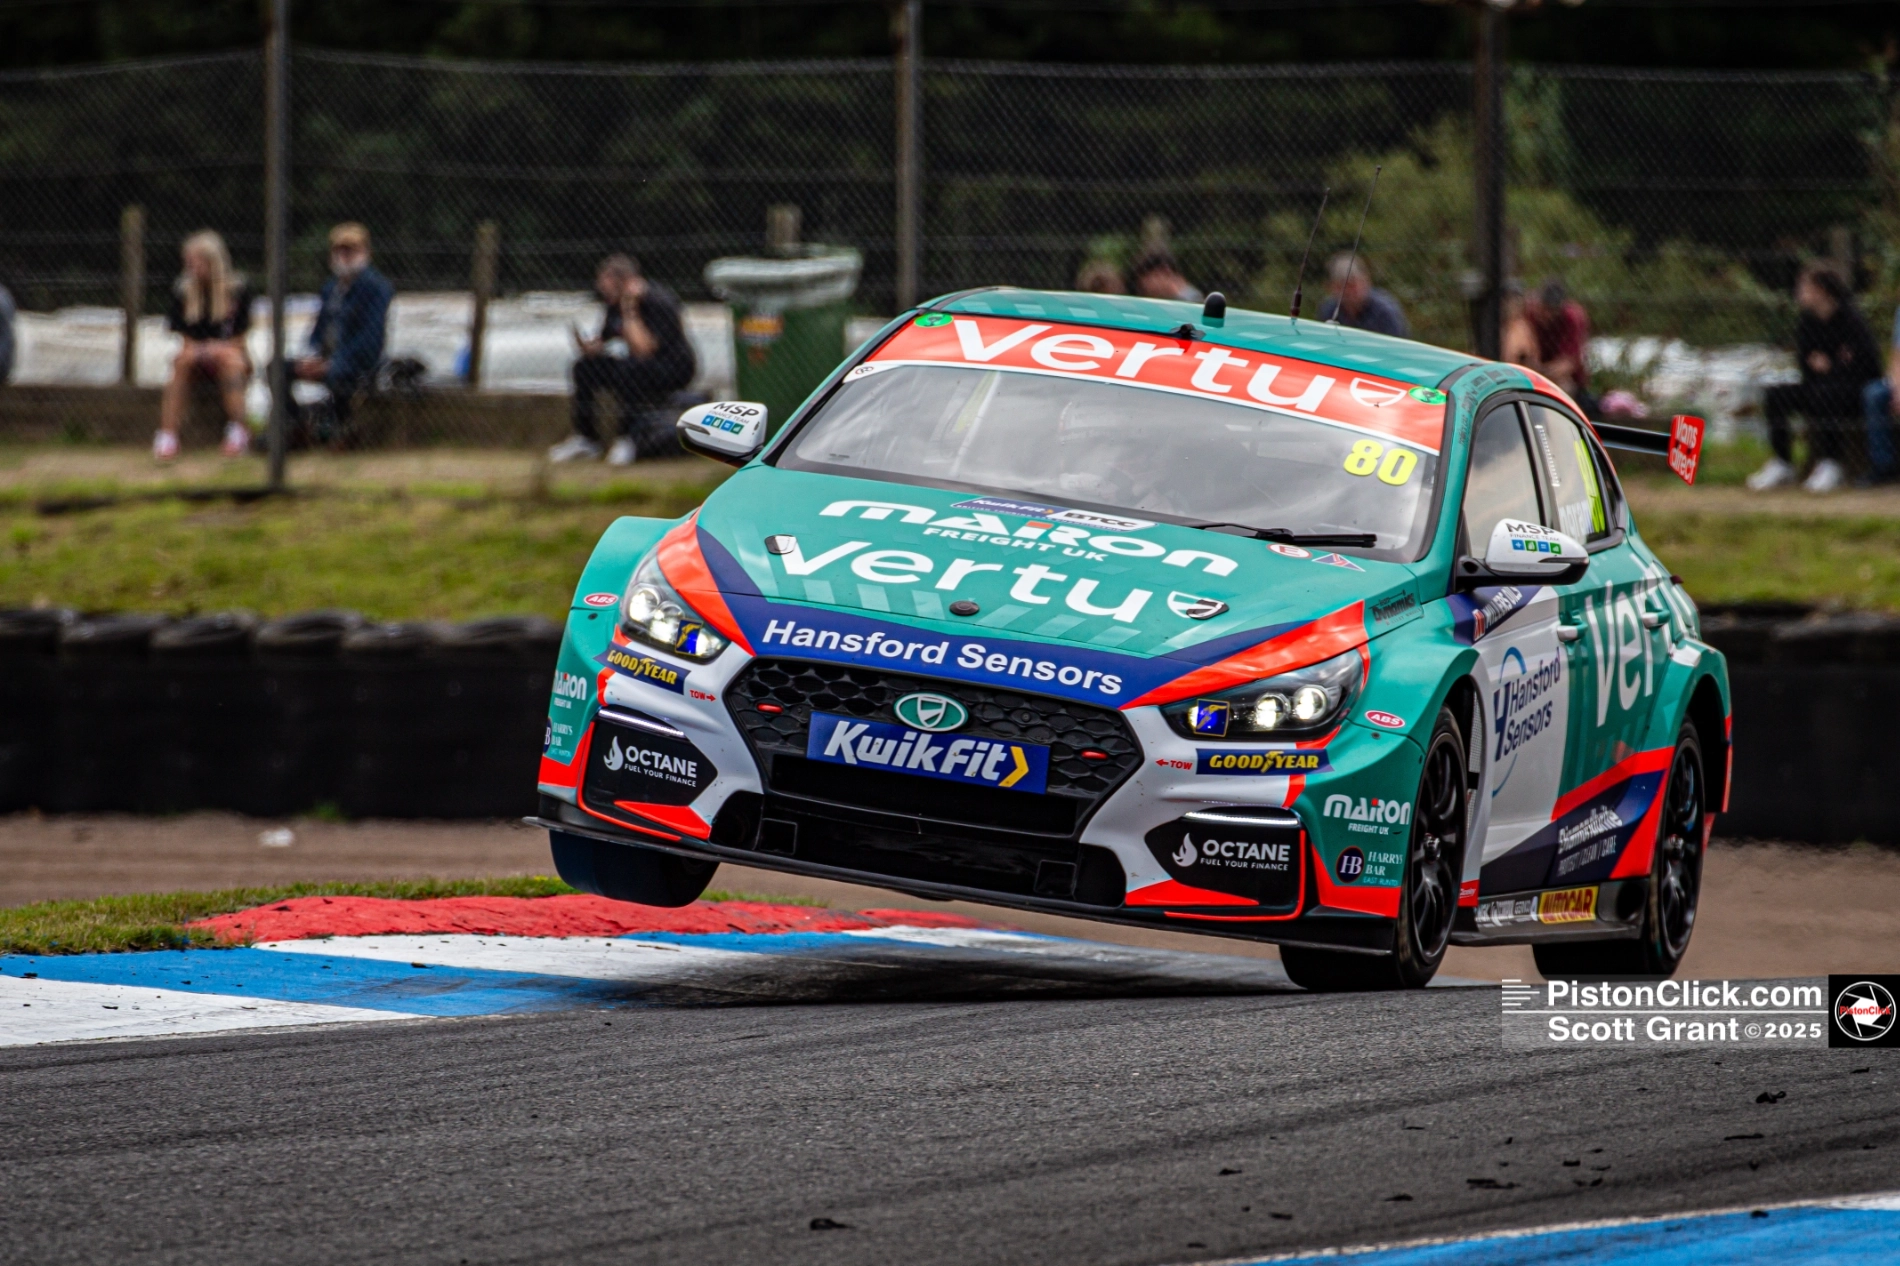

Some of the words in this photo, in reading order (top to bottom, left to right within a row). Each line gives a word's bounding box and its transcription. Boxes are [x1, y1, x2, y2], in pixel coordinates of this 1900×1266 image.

[954, 319, 1335, 412] Vertu
[713, 402, 760, 417] MSP
[1675, 416, 1698, 449] Vans
[1343, 439, 1418, 486] 80
[1670, 443, 1697, 485] direct
[1505, 522, 1555, 536] MSP
[922, 527, 1056, 552] FREIGHT
[1062, 547, 1110, 562] UK
[780, 540, 1154, 624] Vertu
[590, 595, 617, 604] ABS
[762, 619, 949, 665] Hansford
[956, 643, 1123, 695] Sensors
[689, 689, 706, 700] TOW
[1509, 646, 1561, 717] Hansford
[1370, 713, 1400, 725] ABS
[1503, 700, 1553, 756] Sensors
[624, 763, 642, 774] FUEL
[643, 768, 664, 779] YOUR
[665, 773, 697, 788] FINANCE
[625, 745, 698, 779] OCTANE
[1170, 760, 1193, 771] TOW
[1347, 822, 1378, 834] FREIGHT
[1379, 826, 1390, 835] UK
[1200, 857, 1222, 867] FUEL
[1225, 859, 1248, 869] YOUR
[1251, 861, 1289, 871] FINANCE
[1202, 839, 1291, 862] OCTANE
[1365, 864, 1386, 876] BAR
[1542, 888, 1595, 923] AUTOCAR
